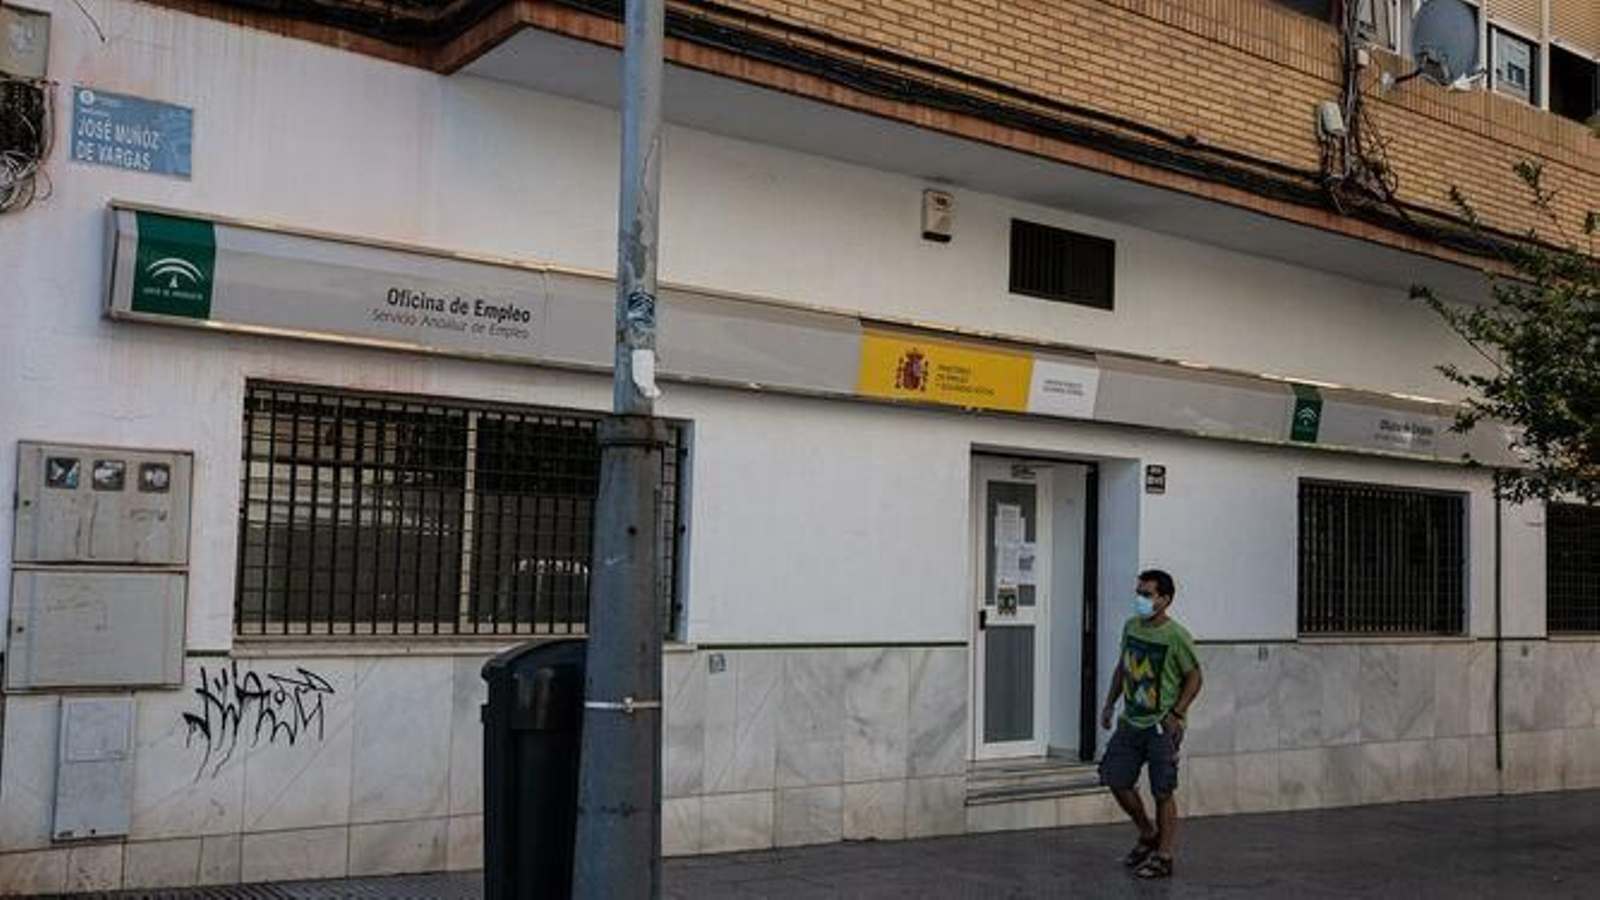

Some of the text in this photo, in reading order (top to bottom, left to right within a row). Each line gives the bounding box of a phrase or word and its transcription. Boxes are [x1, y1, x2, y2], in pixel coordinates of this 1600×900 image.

[77, 115, 112, 141] JOSÉ
[76, 140, 151, 171] DE VARGAS
[387, 287, 531, 324] Oficina de Empleo
